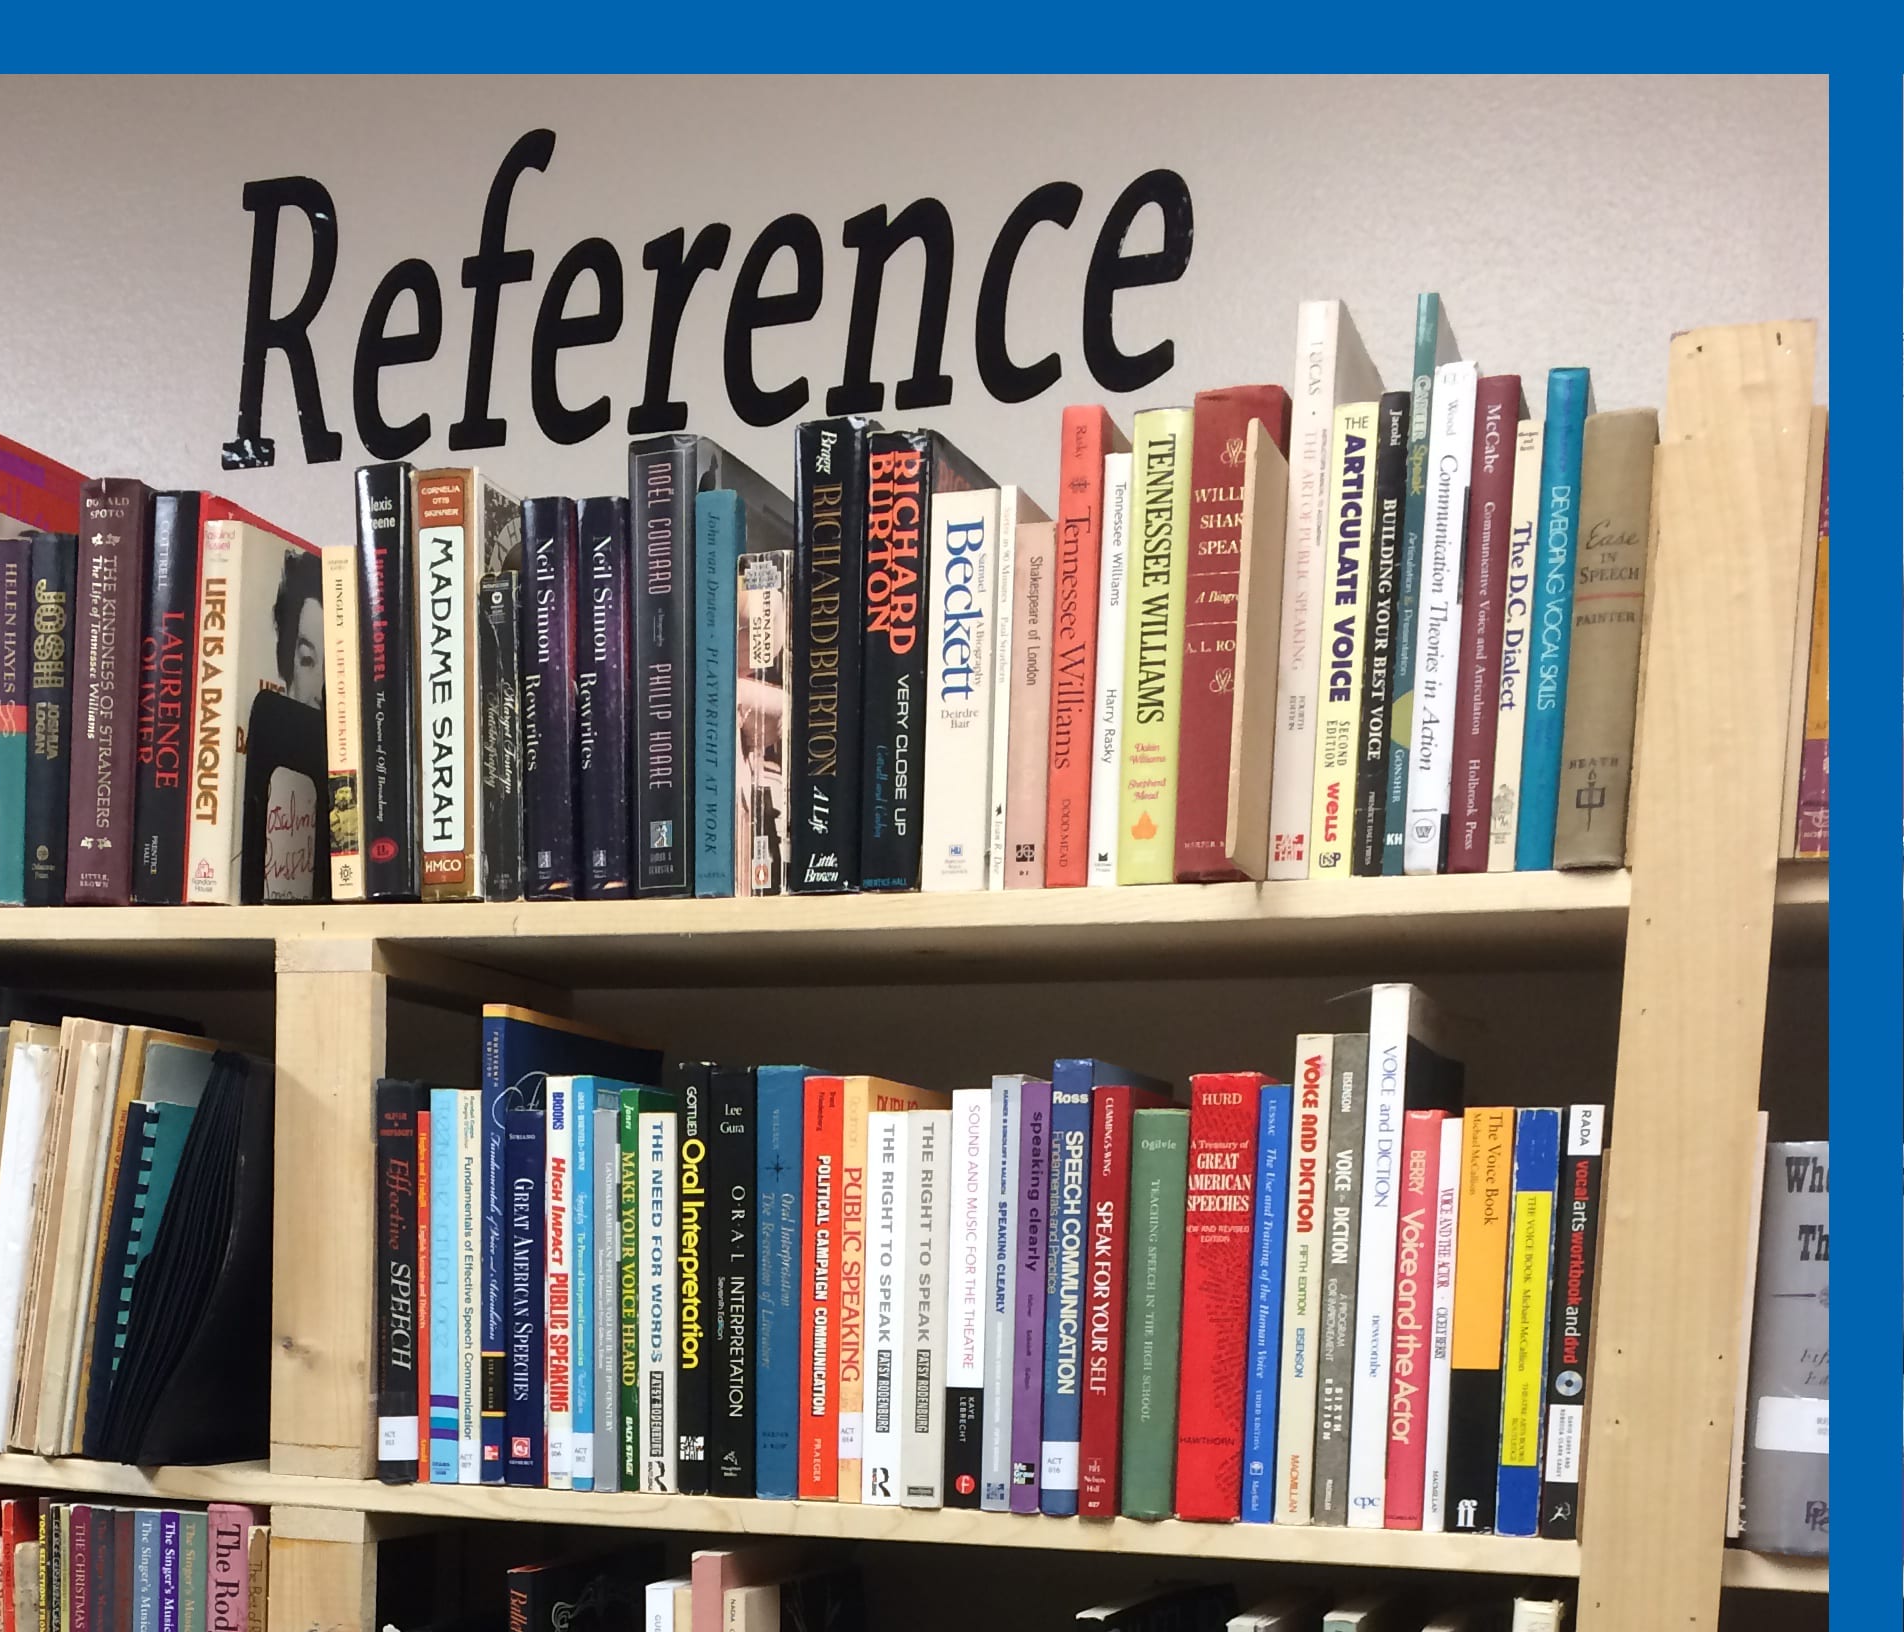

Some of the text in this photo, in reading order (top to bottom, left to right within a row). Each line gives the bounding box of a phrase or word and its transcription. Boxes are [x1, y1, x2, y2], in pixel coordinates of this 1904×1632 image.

[221, 129, 1193, 470] Reference
[1345, 415, 1368, 430] THE
[866, 452, 893, 632] BURTON
[890, 450, 920, 654] RICHARD
[941, 517, 985, 701] Beckett
[1136, 434, 1176, 724] TENNESSEE WILLIAMS
[1329, 434, 1366, 703] ARTICULATE VOICE
[1580, 566, 1639, 583] SPEECH
[34, 579, 65, 688] JOSH
[428, 537, 453, 841] MADAME SARAH
[720, 1121, 744, 1133] Gura
[725, 1104, 742, 1115] Lee
[1052, 1091, 1088, 1104] Ross
[1141, 1140, 1176, 1149] Ogilvie
[1202, 1093, 1242, 1105] HURD
[650, 1121, 665, 1364] THE NEED FOR WORDS
[682, 1138, 706, 1368] Oral Interpretation
